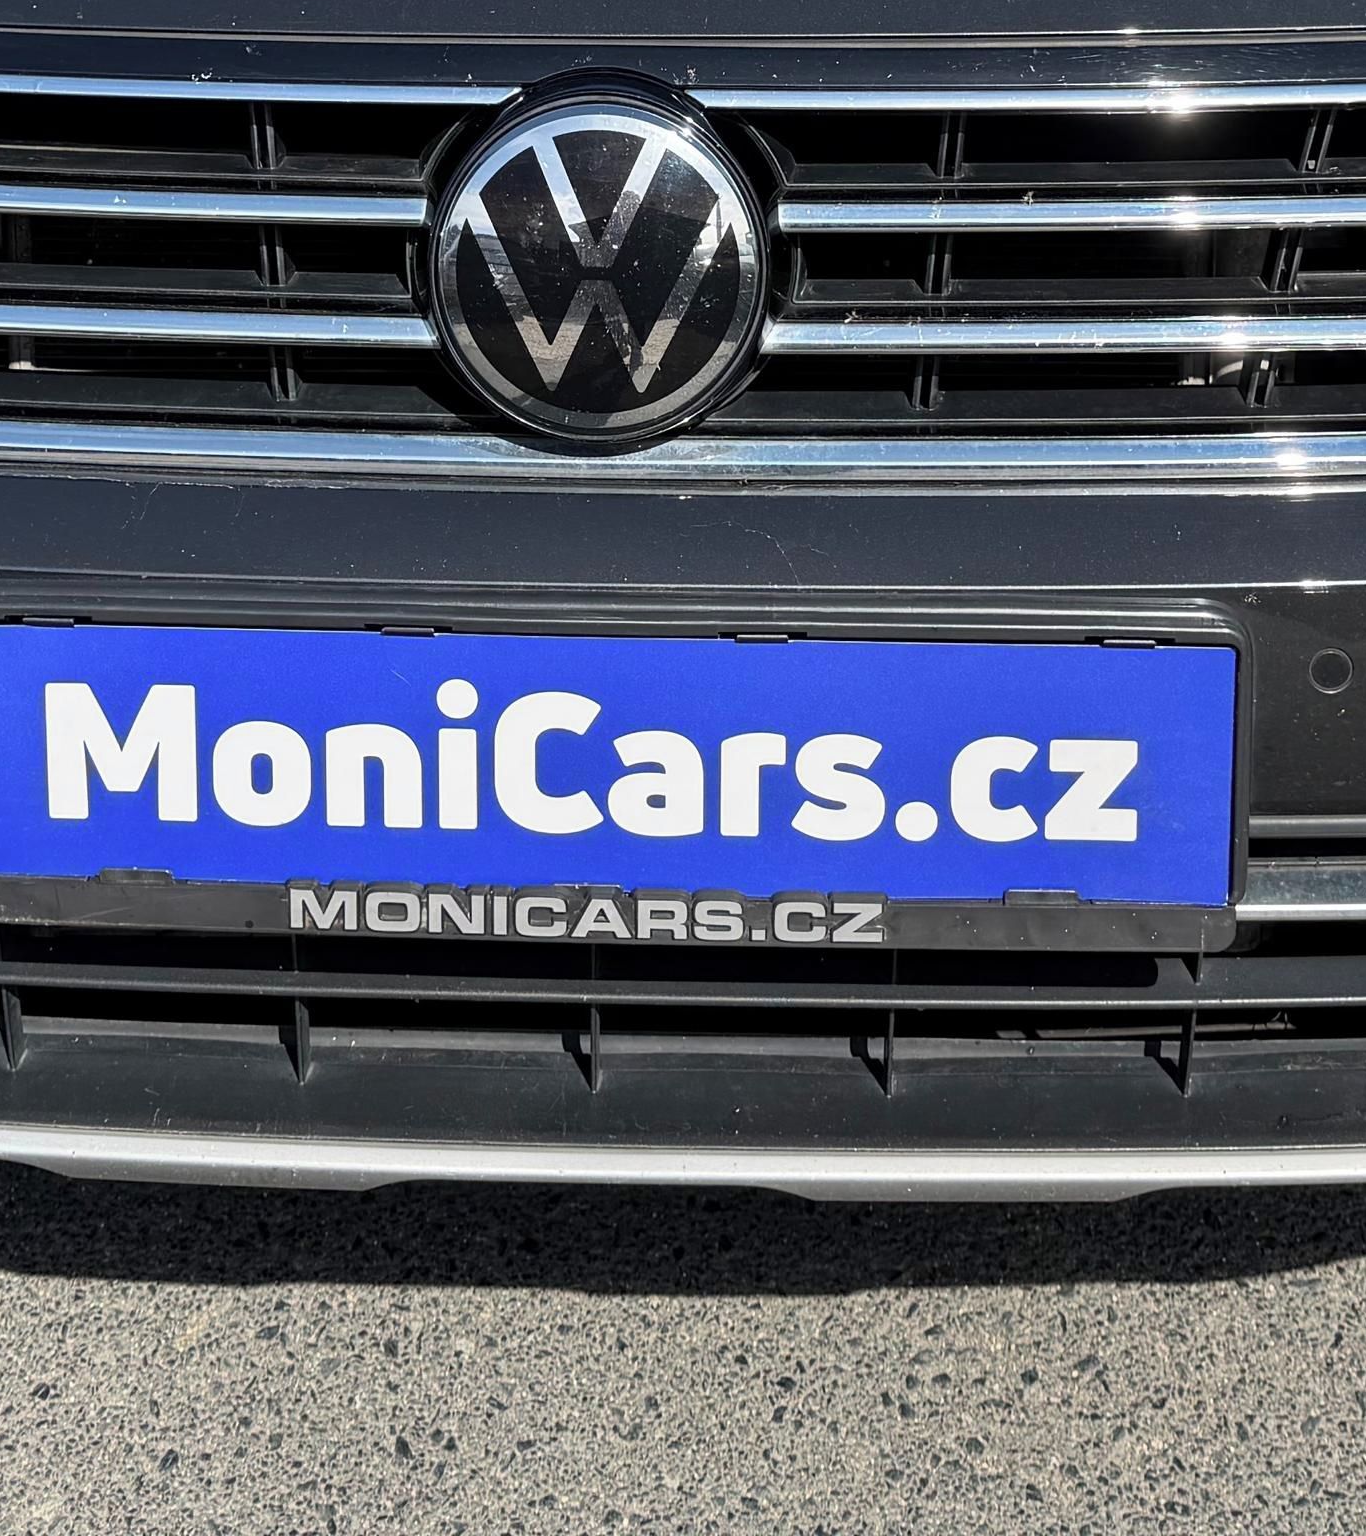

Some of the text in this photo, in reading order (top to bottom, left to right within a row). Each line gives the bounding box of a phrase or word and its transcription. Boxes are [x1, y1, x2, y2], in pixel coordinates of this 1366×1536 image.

[457, 116, 741, 398] VW
[44, 677, 1140, 843] MoniCars.cz
[289, 888, 885, 944] MONICARS.CZ
